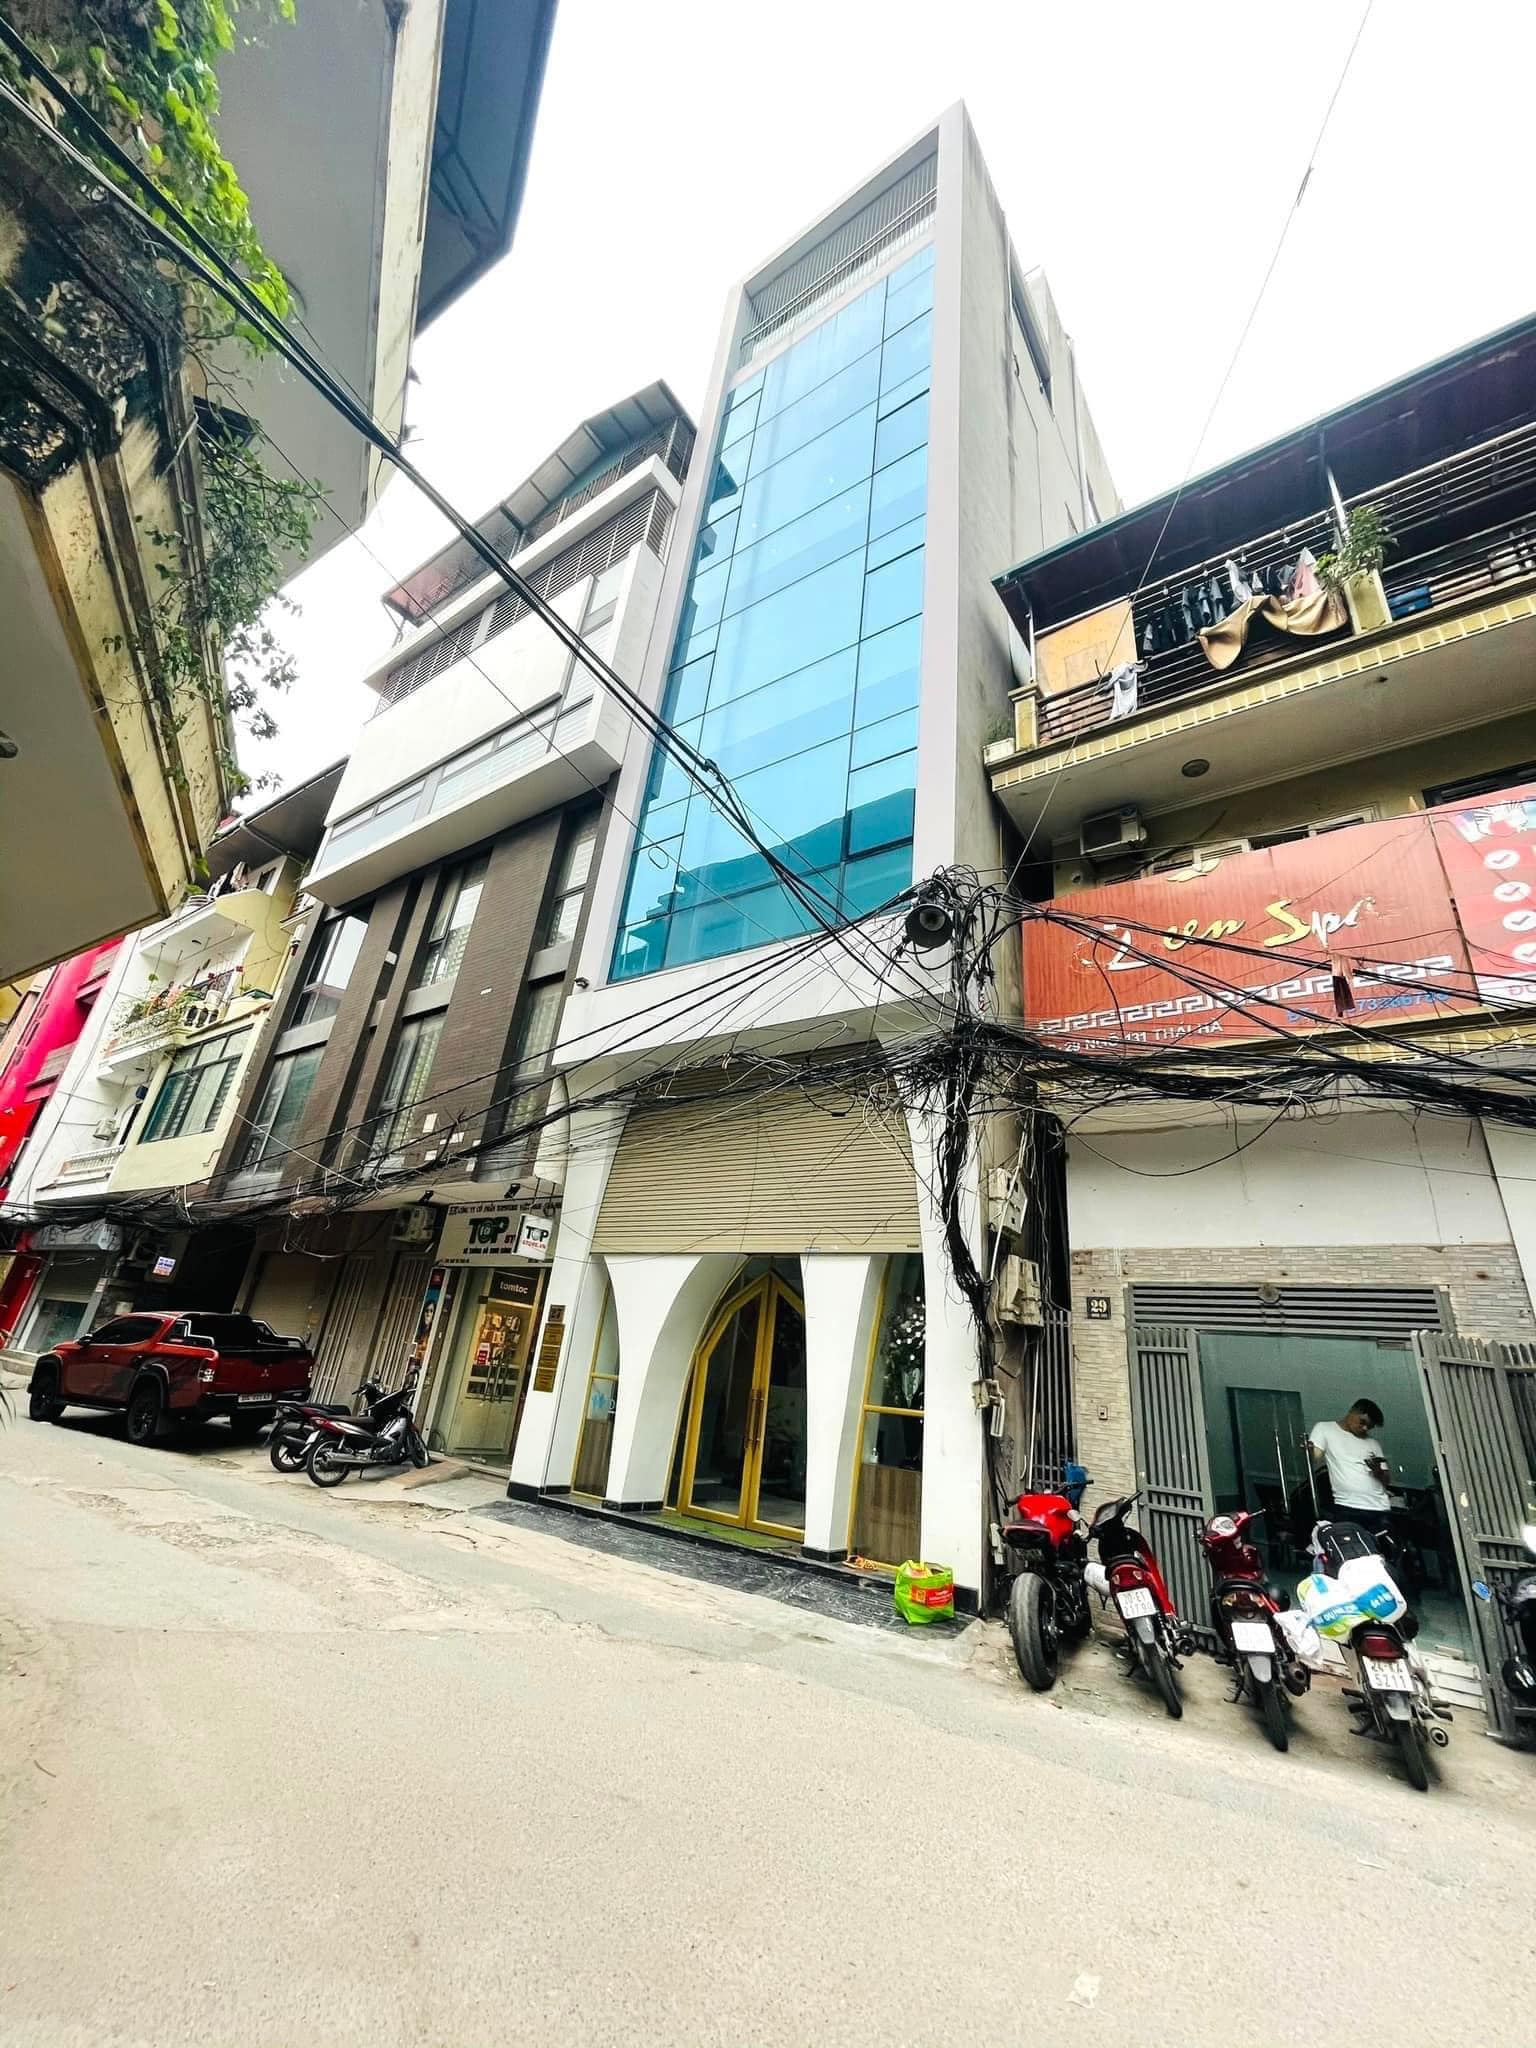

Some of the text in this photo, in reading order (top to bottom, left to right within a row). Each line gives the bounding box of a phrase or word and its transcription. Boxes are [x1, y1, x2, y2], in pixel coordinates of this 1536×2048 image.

[1124, 1031, 1147, 1043] 131
[468, 1216, 510, 1245] TOP
[525, 1225, 550, 1243] TOP
[500, 1281, 529, 1294] tomtoc
[1090, 1299, 1107, 1313] 29
